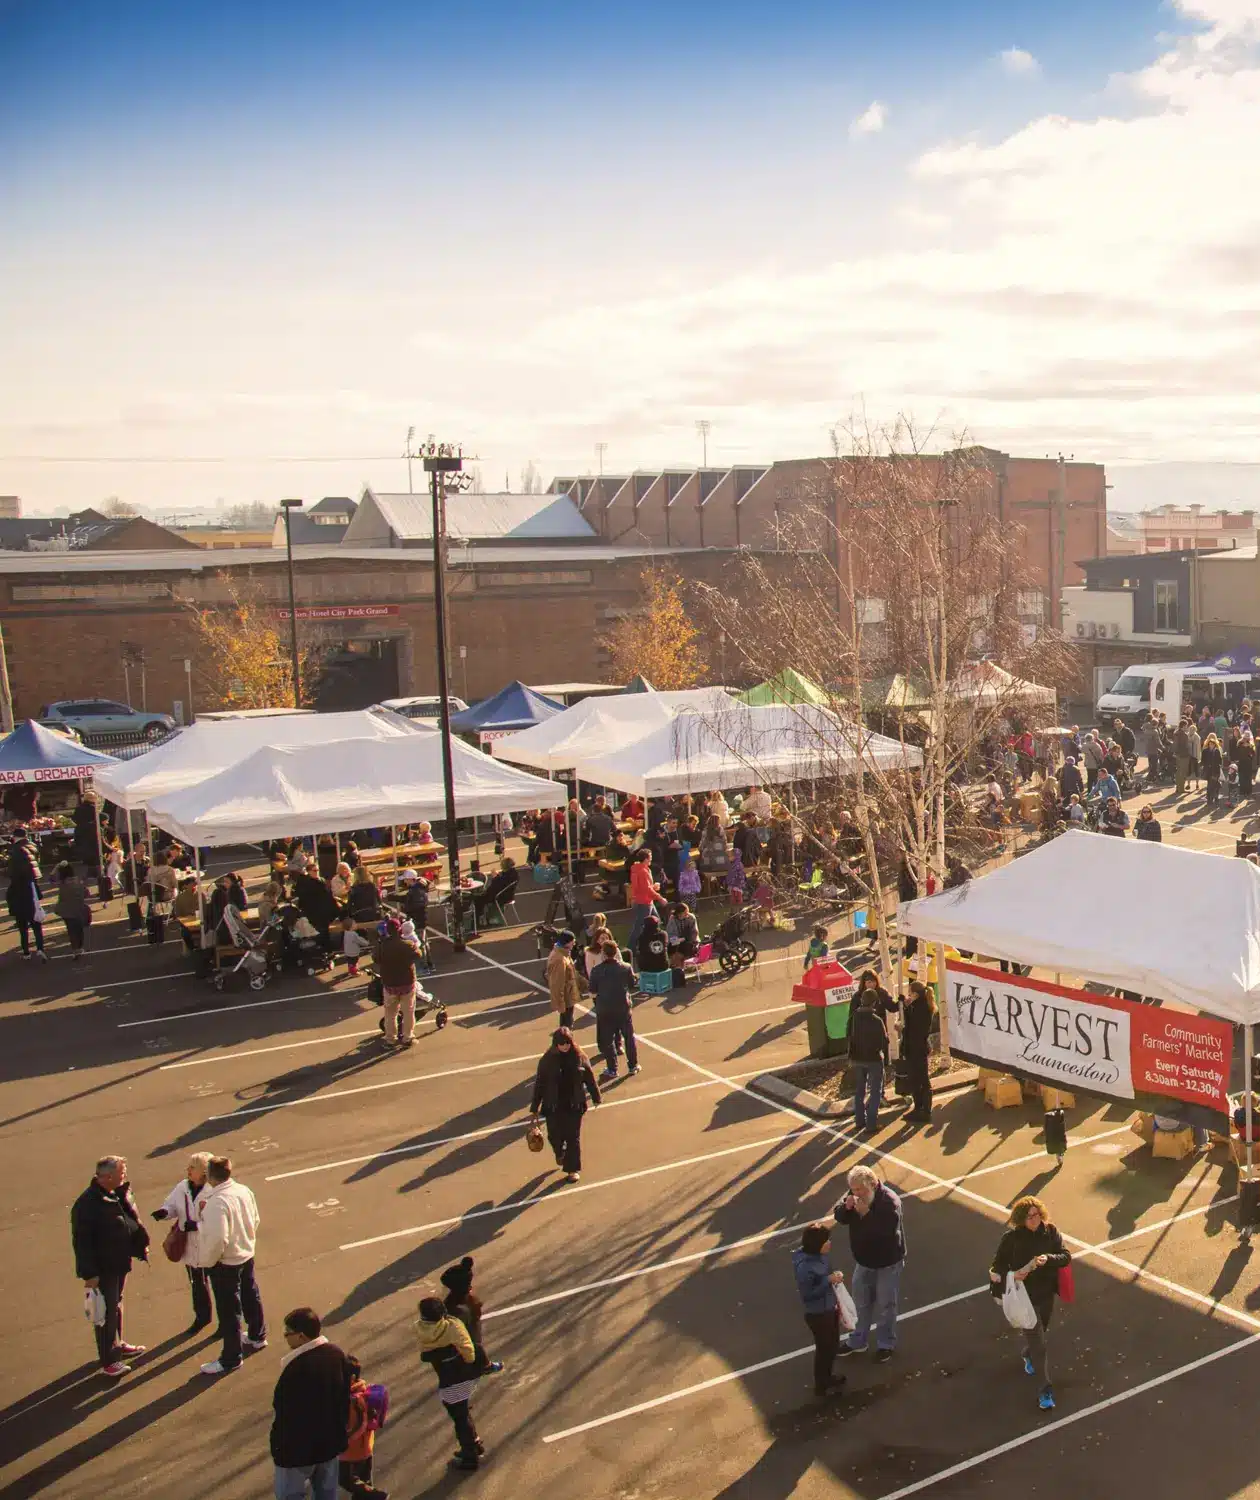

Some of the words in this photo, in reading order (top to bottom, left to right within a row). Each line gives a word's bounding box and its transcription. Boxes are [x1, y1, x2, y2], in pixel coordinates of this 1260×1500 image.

[331, 609, 346, 617] City
[348, 608, 365, 616] Park
[366, 607, 388, 615] Grand
[832, 987, 856, 996] GENERAL
[952, 981, 1119, 1062] HARVEST
[1164, 1023, 1222, 1049] Community
[1016, 1036, 1120, 1085] Launceston
[1185, 1044, 1224, 1063] Market
[1145, 1071, 1179, 1087] 8.30am
[1155, 1058, 1180, 1076] Every
[1181, 1064, 1223, 1086] Saturday
